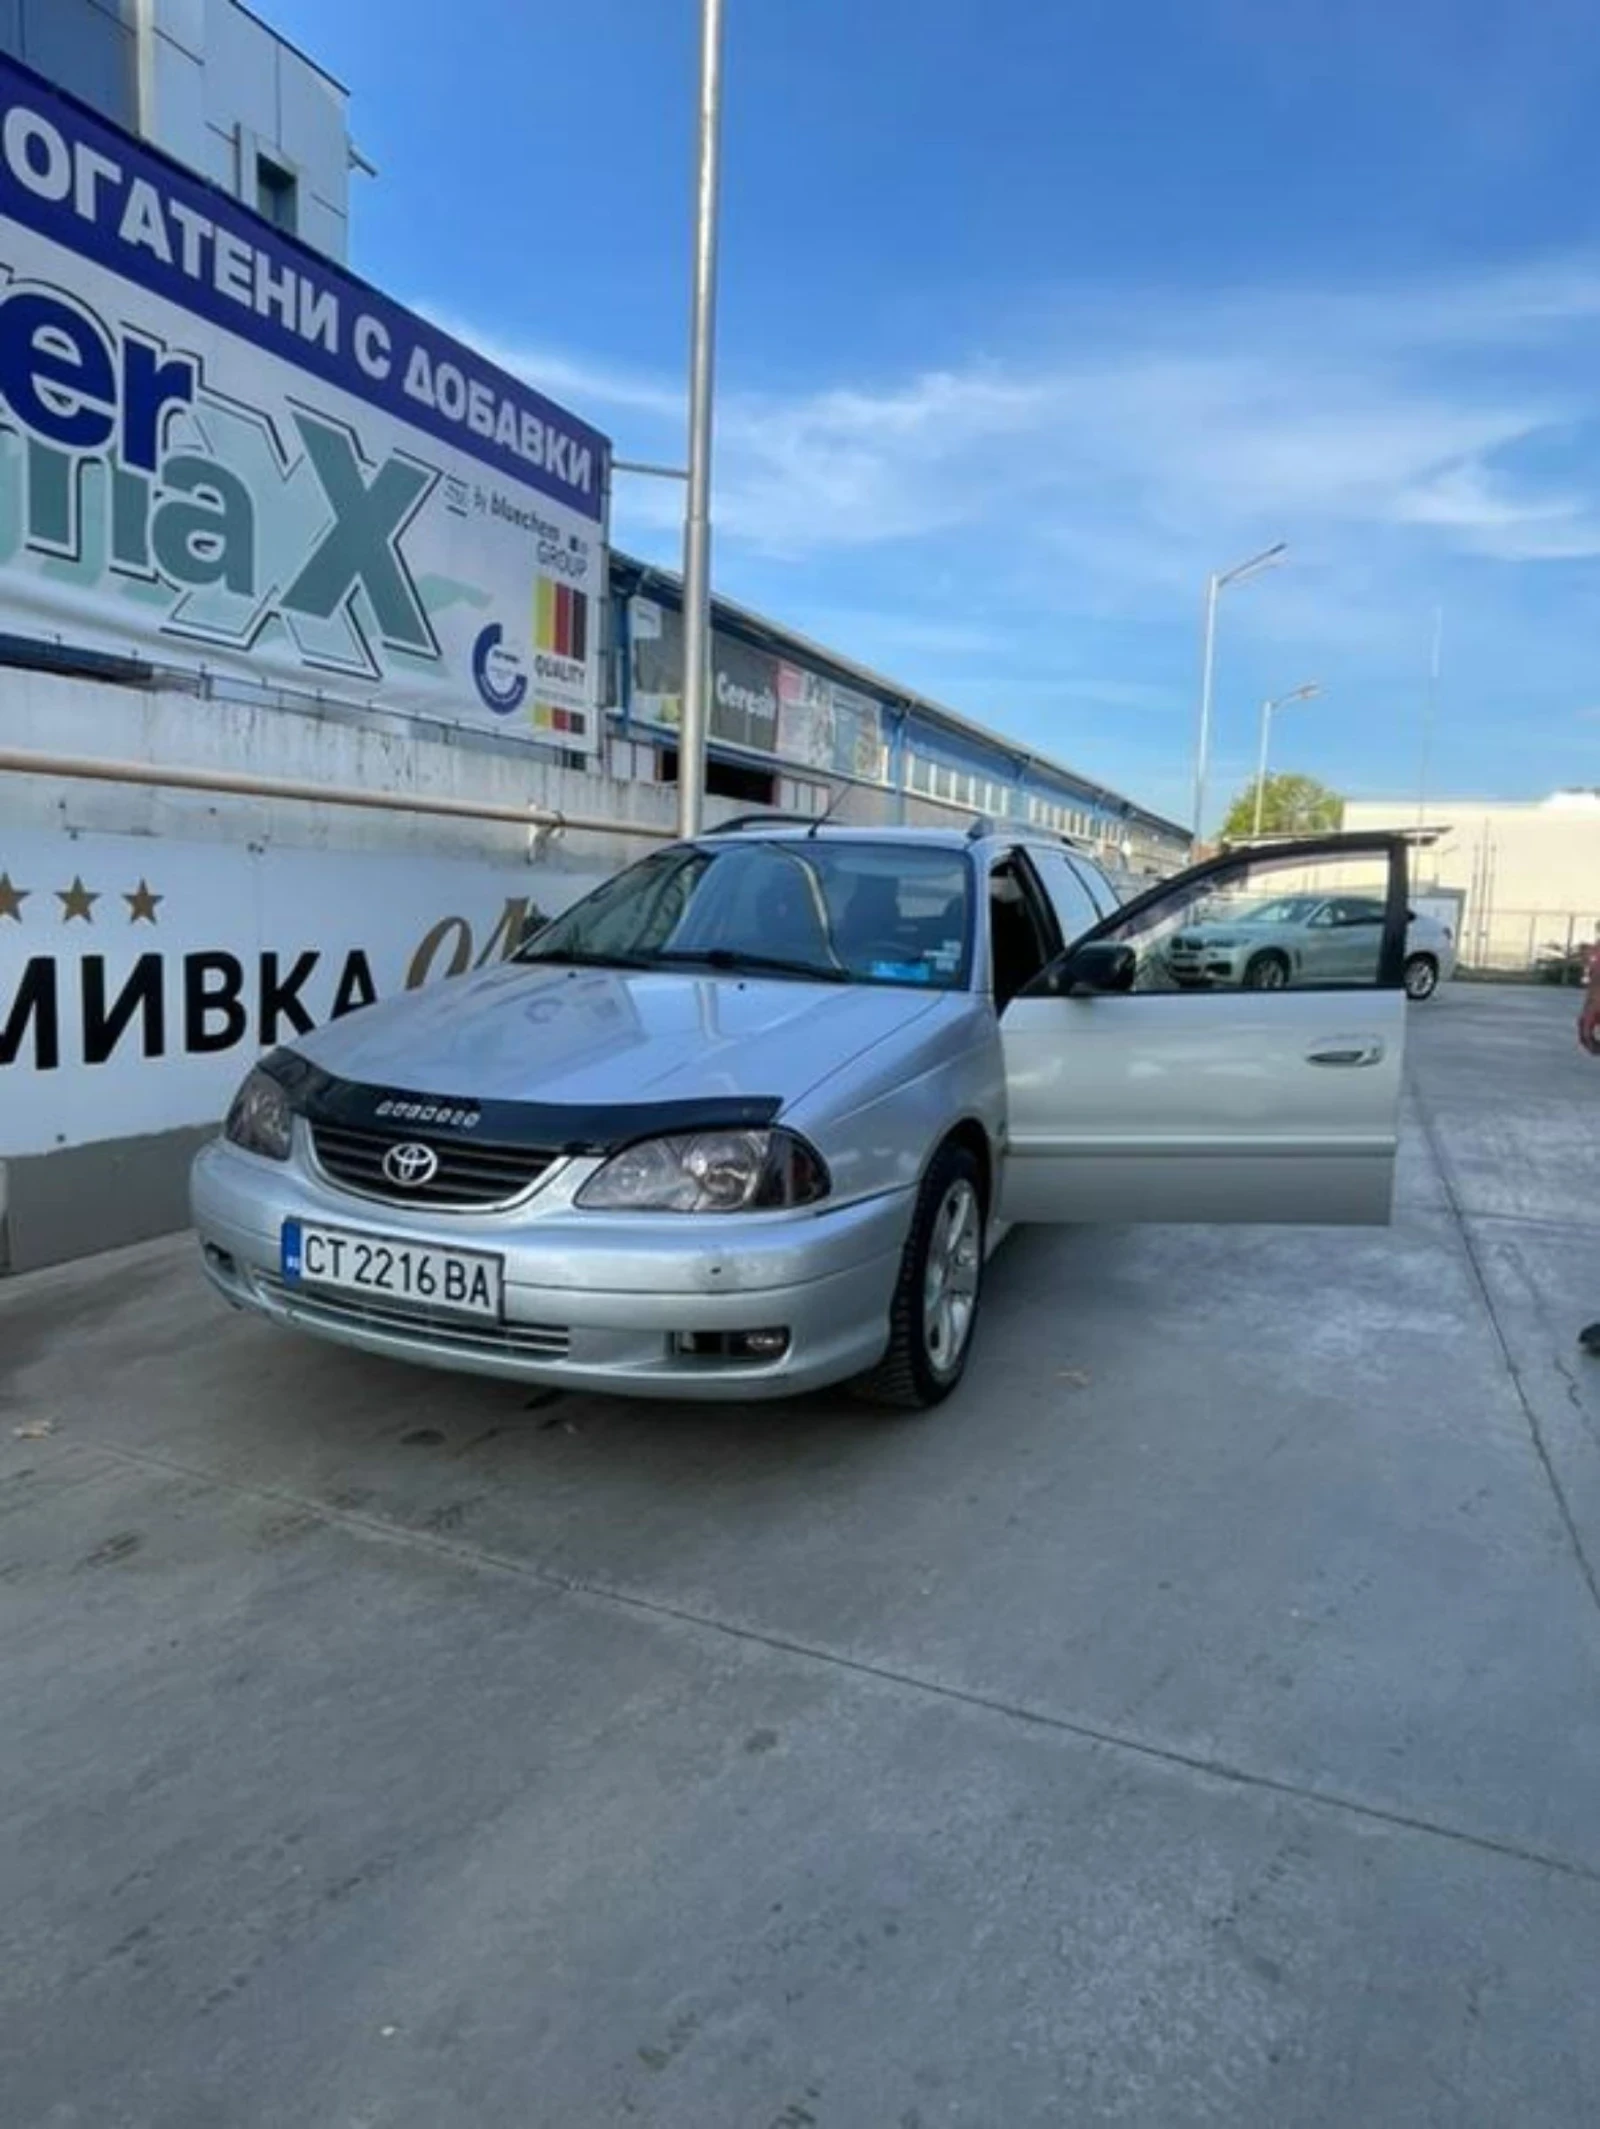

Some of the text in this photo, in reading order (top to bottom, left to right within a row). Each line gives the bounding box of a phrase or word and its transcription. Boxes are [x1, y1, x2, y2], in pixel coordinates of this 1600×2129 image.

[3, 106, 592, 494] ОГАТЕНИ С ДОБАВКИ
[537, 539, 589, 577] GROUP
[354, 1244, 437, 1296] 2216
